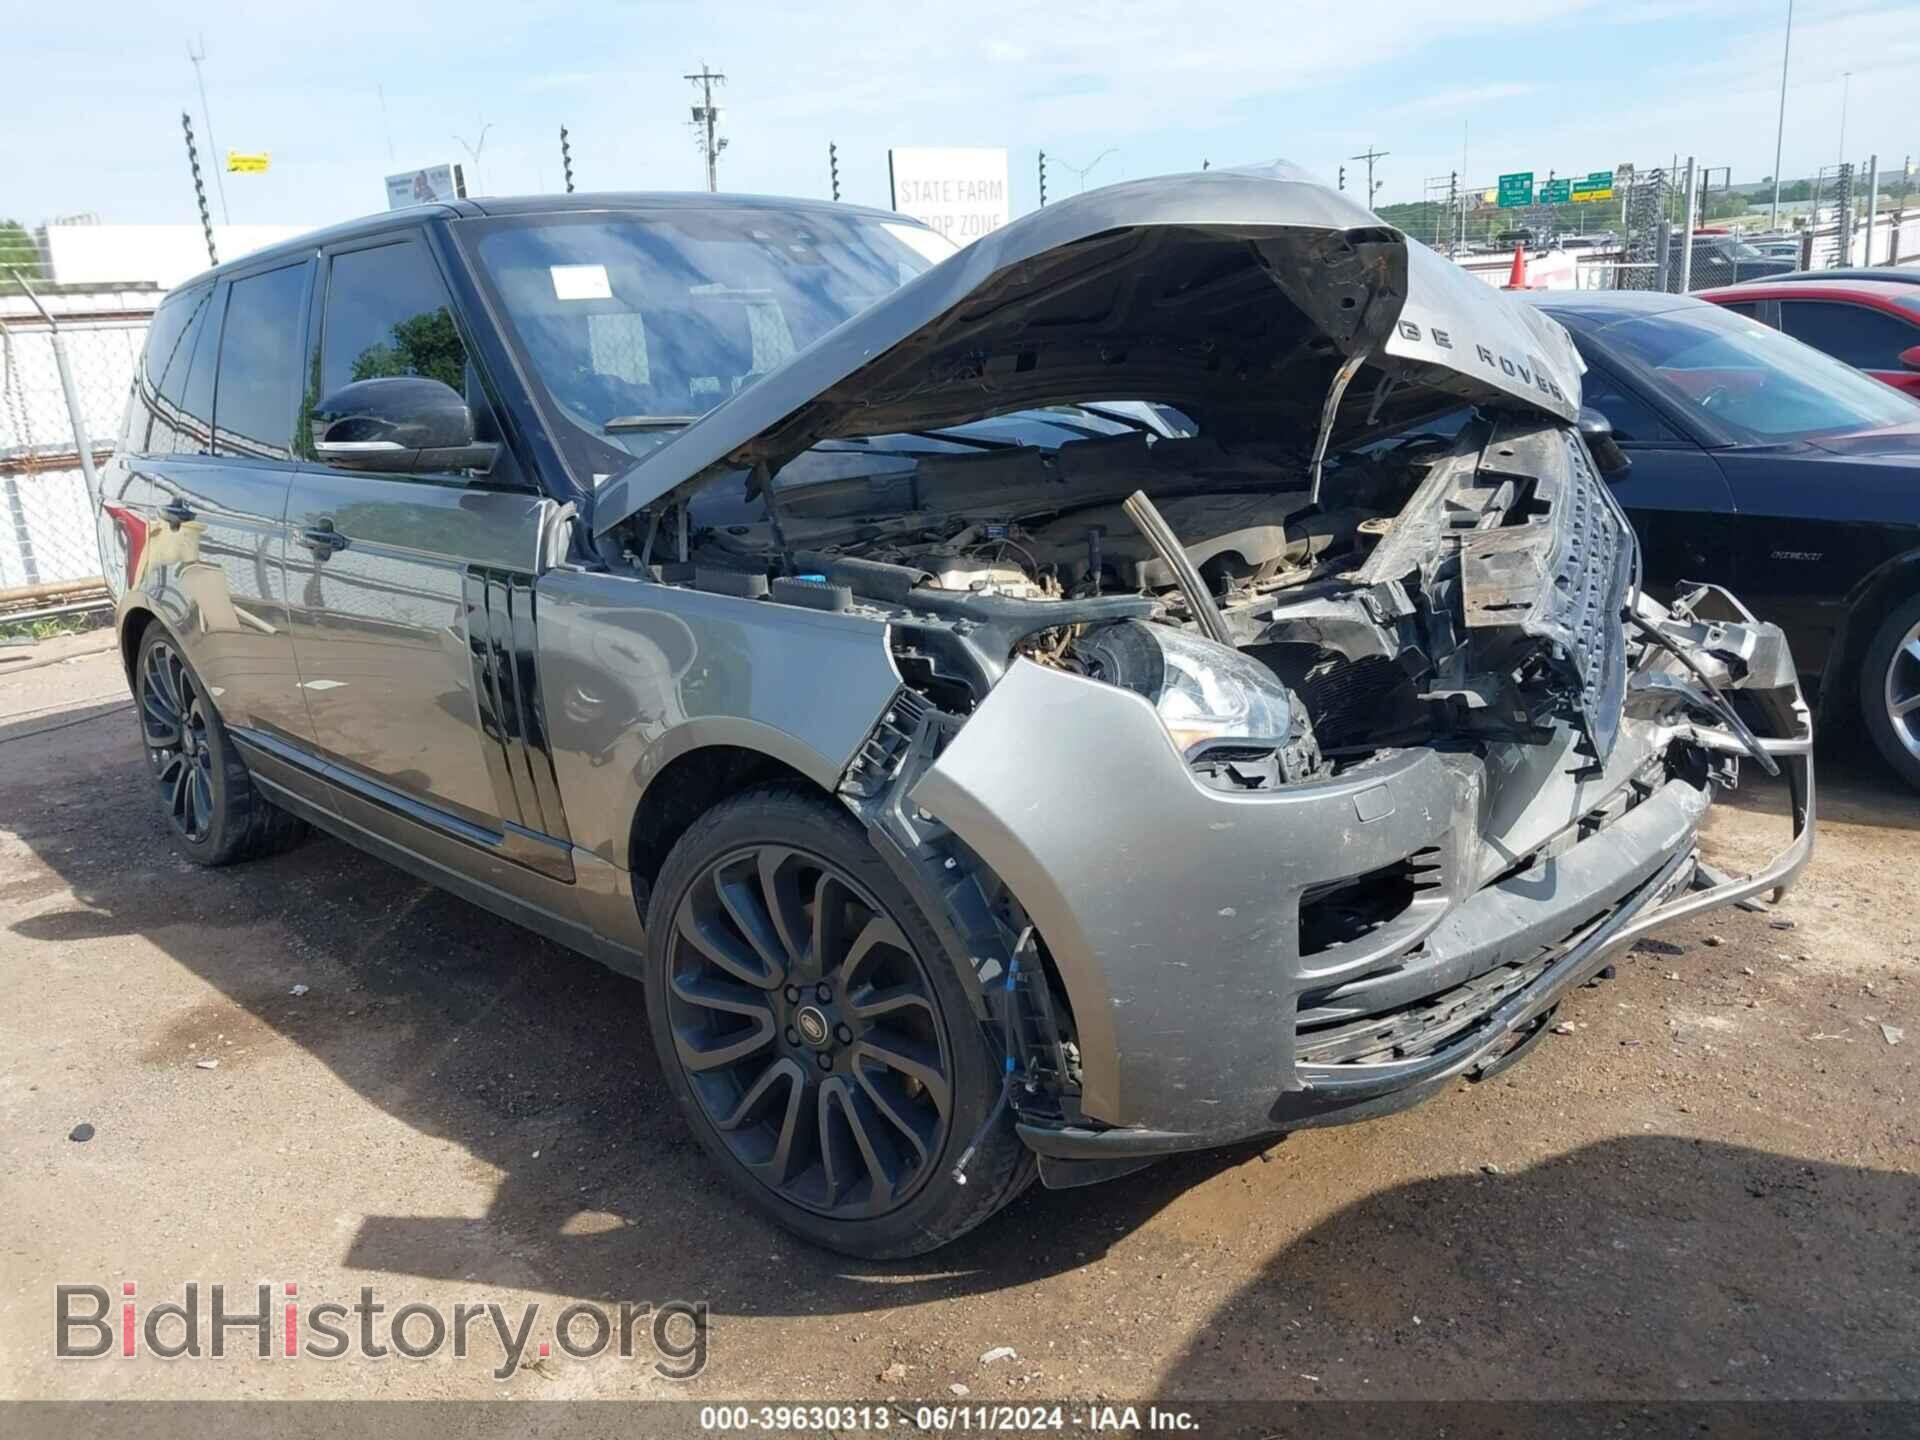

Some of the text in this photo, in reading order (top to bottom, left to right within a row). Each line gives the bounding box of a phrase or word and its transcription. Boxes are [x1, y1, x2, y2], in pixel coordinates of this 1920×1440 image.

[901, 180, 1002, 202] STATE FARM
[1476, 344, 1563, 402] ROVER
